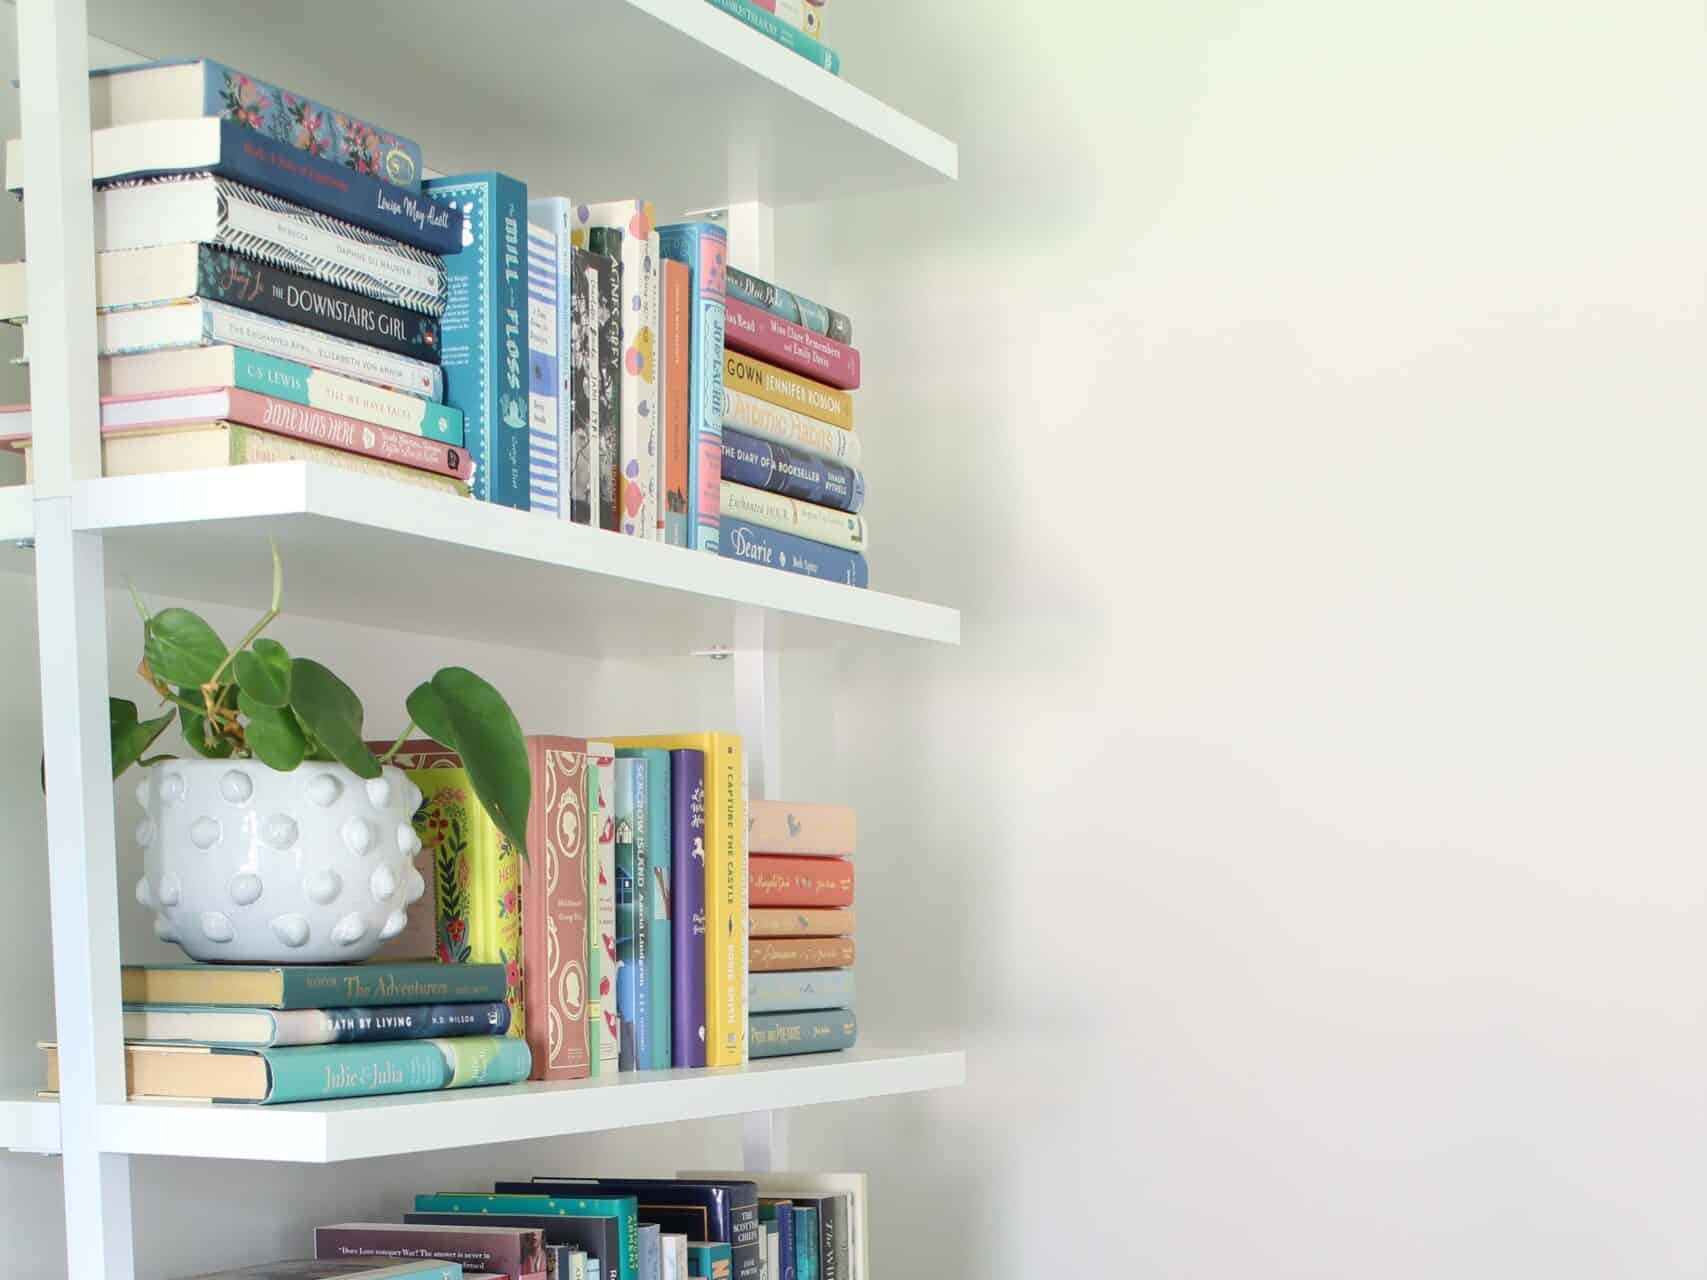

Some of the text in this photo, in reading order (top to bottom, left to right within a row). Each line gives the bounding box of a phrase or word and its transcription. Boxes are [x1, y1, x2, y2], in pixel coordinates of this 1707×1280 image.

[505, 217, 520, 282] MILL
[609, 255, 619, 318] AGNES
[287, 285, 375, 331] DOWNSTAIRS
[379, 314, 407, 341] GIRL
[504, 308, 520, 390] FLOSS
[727, 359, 762, 384] GOWN
[766, 374, 806, 401] JENNIFER
[722, 445, 735, 458] THE
[737, 450, 758, 465] DIARY
[761, 455, 770, 468] OF
[778, 462, 820, 481] BOOKSELLER
[731, 527, 772, 564] Dearie
[637, 838, 645, 887] ISLAND
[360, 1017, 412, 1029] BY LIVING
[450, 1016, 475, 1024] WILSON
[371, 1062, 404, 1090] Julia
